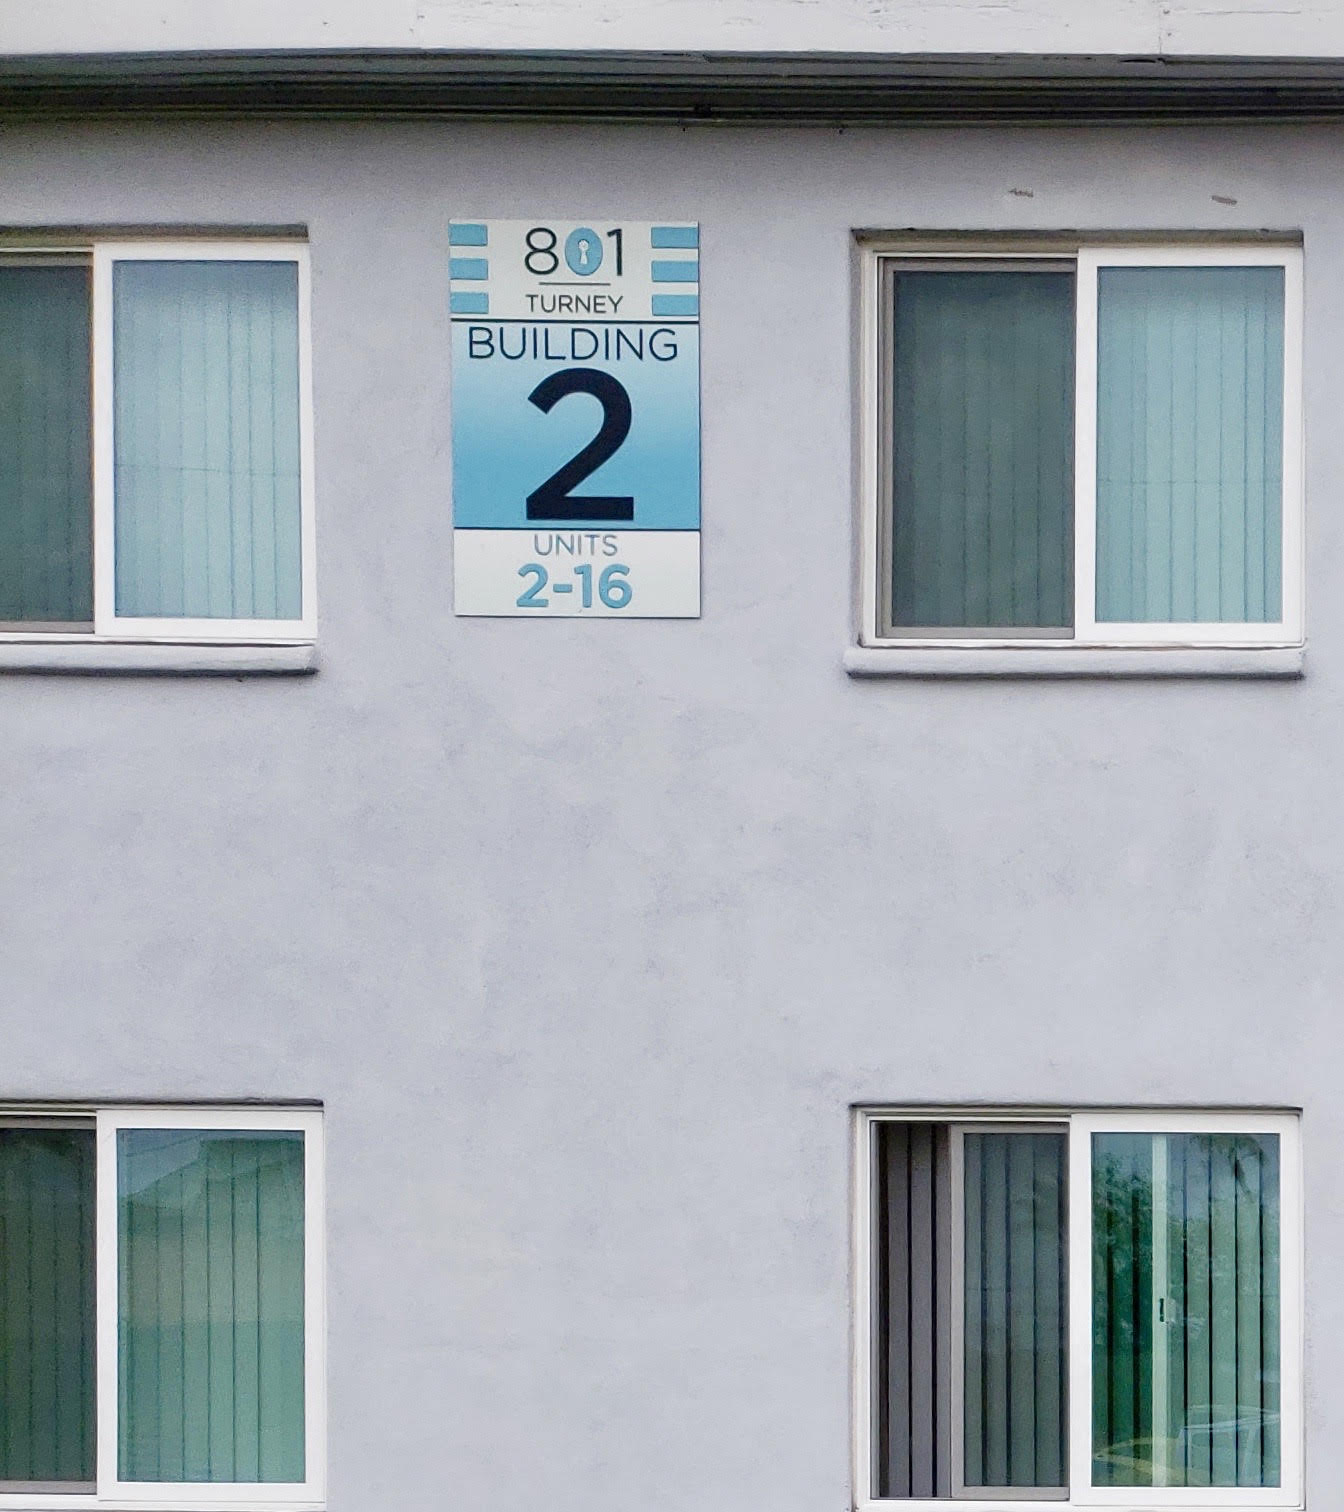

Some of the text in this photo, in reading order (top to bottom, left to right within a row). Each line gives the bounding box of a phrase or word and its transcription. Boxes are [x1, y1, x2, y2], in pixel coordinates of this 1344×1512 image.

[525, 227, 623, 276] 801
[525, 294, 624, 314] TURNEY
[468, 326, 678, 361] BUILDING
[526, 367, 634, 521] 2
[534, 534, 618, 556] UNITS
[516, 563, 633, 609] 2-16
